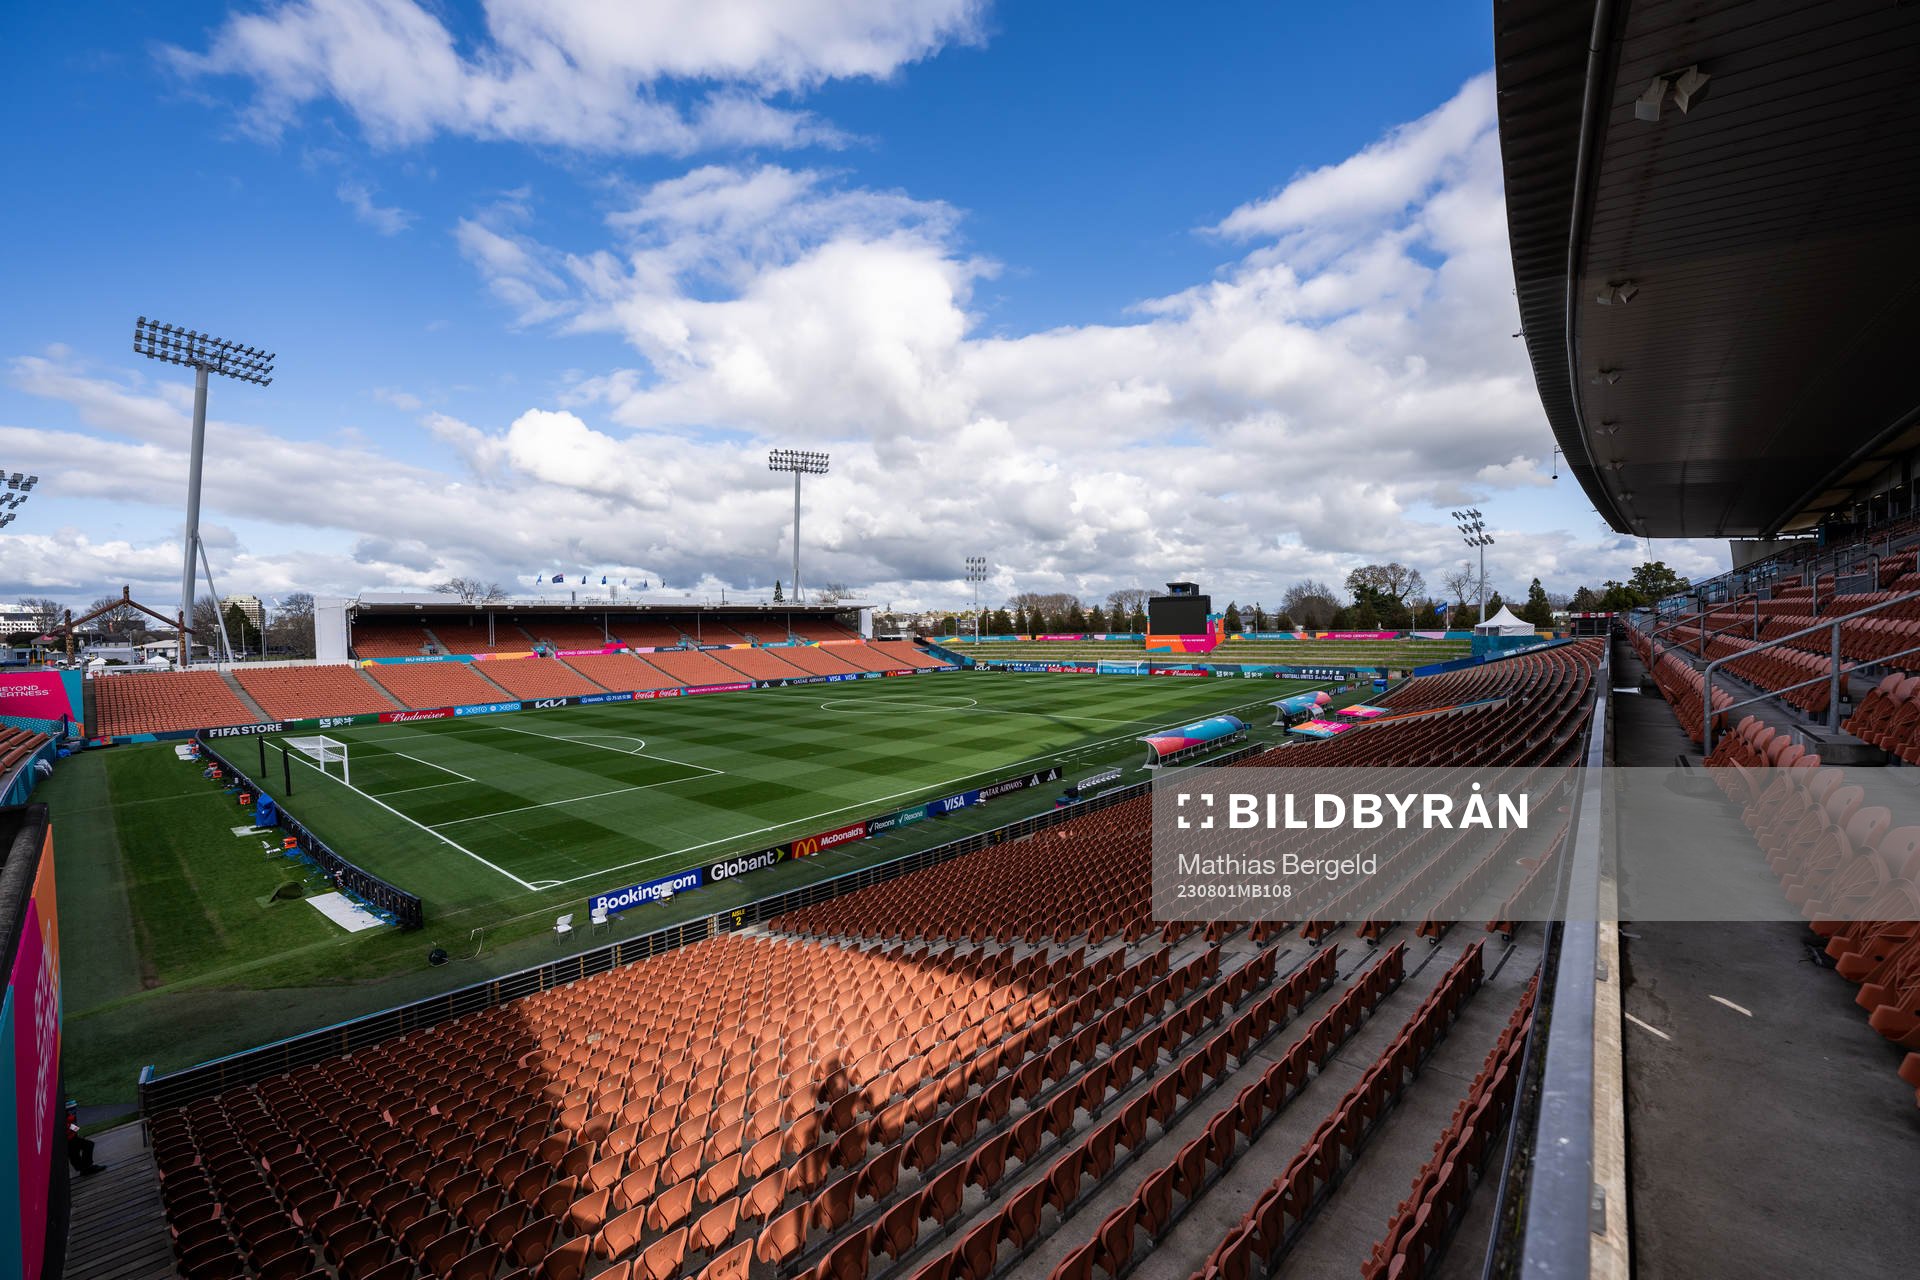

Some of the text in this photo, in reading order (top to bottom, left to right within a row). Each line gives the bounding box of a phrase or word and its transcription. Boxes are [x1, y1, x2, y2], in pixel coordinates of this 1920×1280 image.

[465, 706, 487, 714] xero
[500, 703, 520, 712] xero
[390, 711, 445, 723] Budweiser
[209, 723, 283, 738] FIFA STORE
[999, 780, 1024, 794] AIRWAYS
[943, 795, 965, 812] VISA
[902, 810, 924, 822] Rexona
[874, 818, 896, 831] Rexona
[820, 826, 864, 847] McDonald's
[710, 851, 776, 881] Globant
[597, 874, 697, 911] Bookingom
[735, 916, 742, 927] 2
